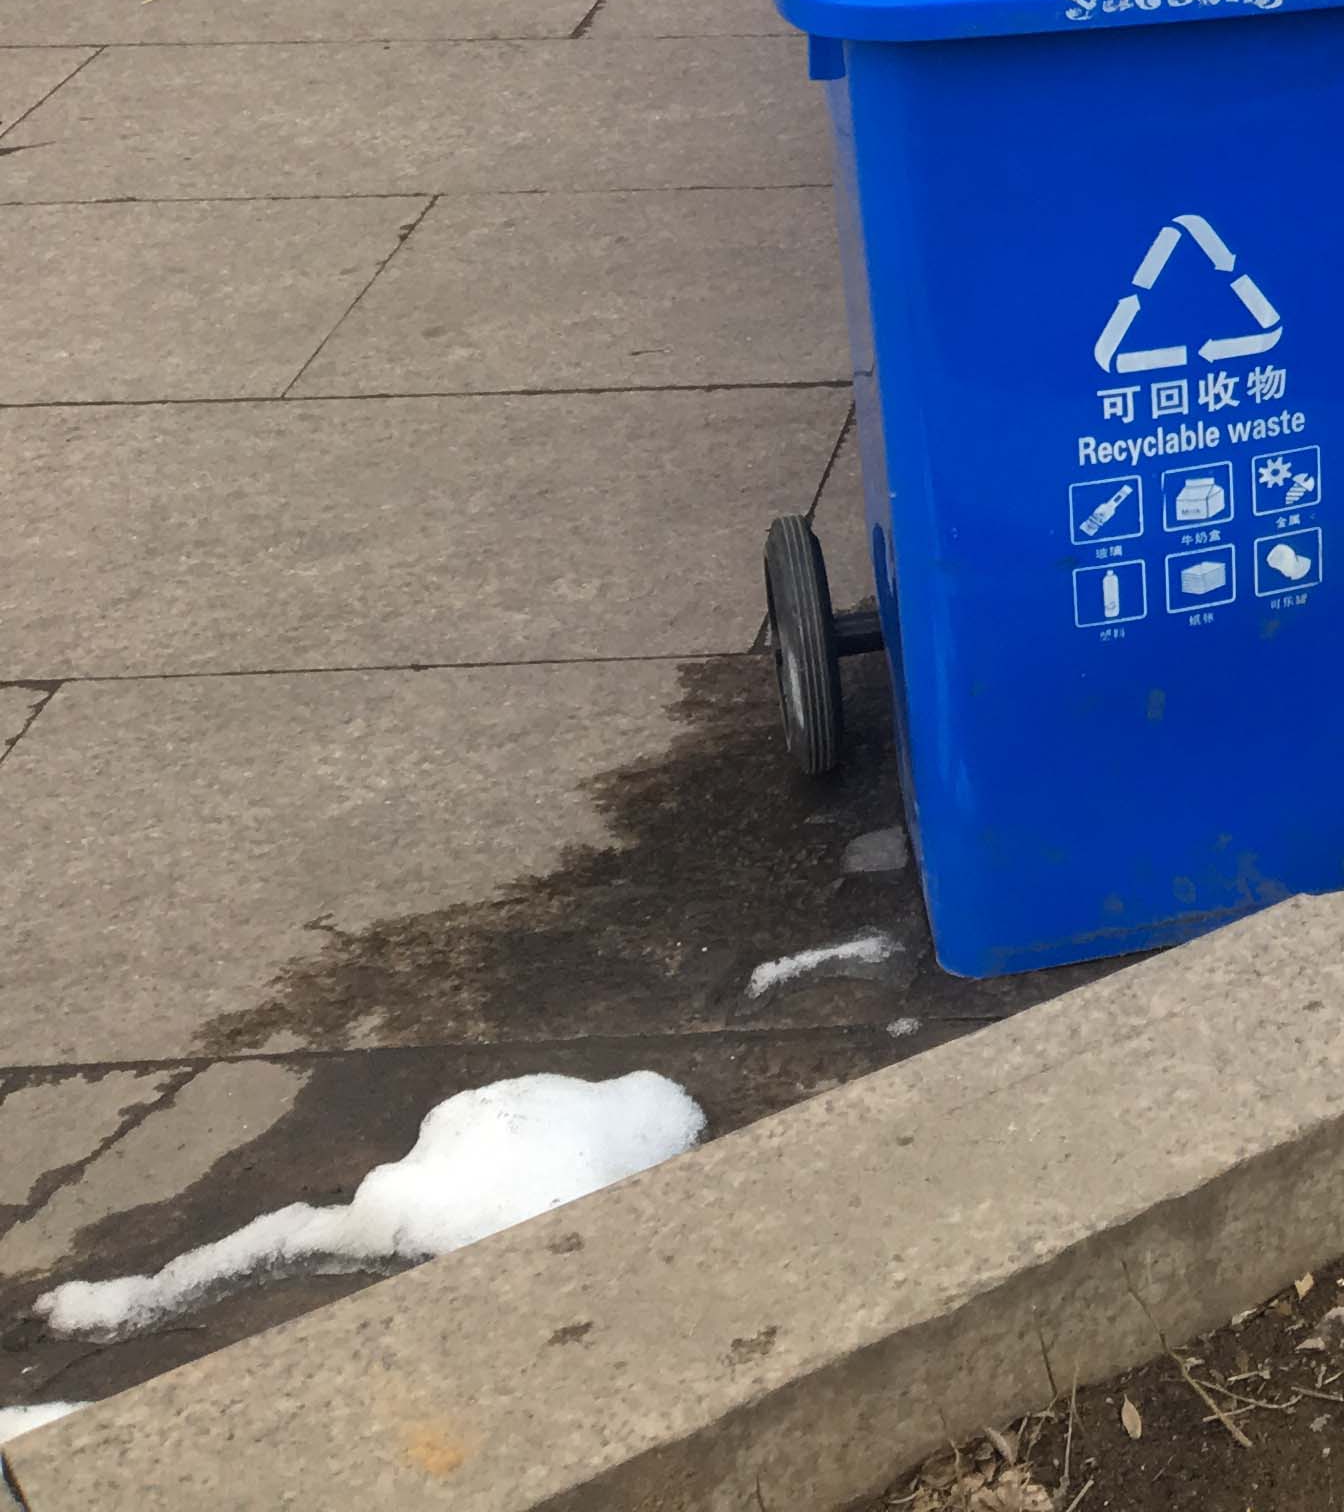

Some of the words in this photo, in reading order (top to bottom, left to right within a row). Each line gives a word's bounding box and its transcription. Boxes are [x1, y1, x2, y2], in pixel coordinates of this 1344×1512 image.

[1097, 365, 1287, 424] 可回收物
[1078, 420, 1220, 466] Recyclable
[1228, 409, 1306, 444] waste
